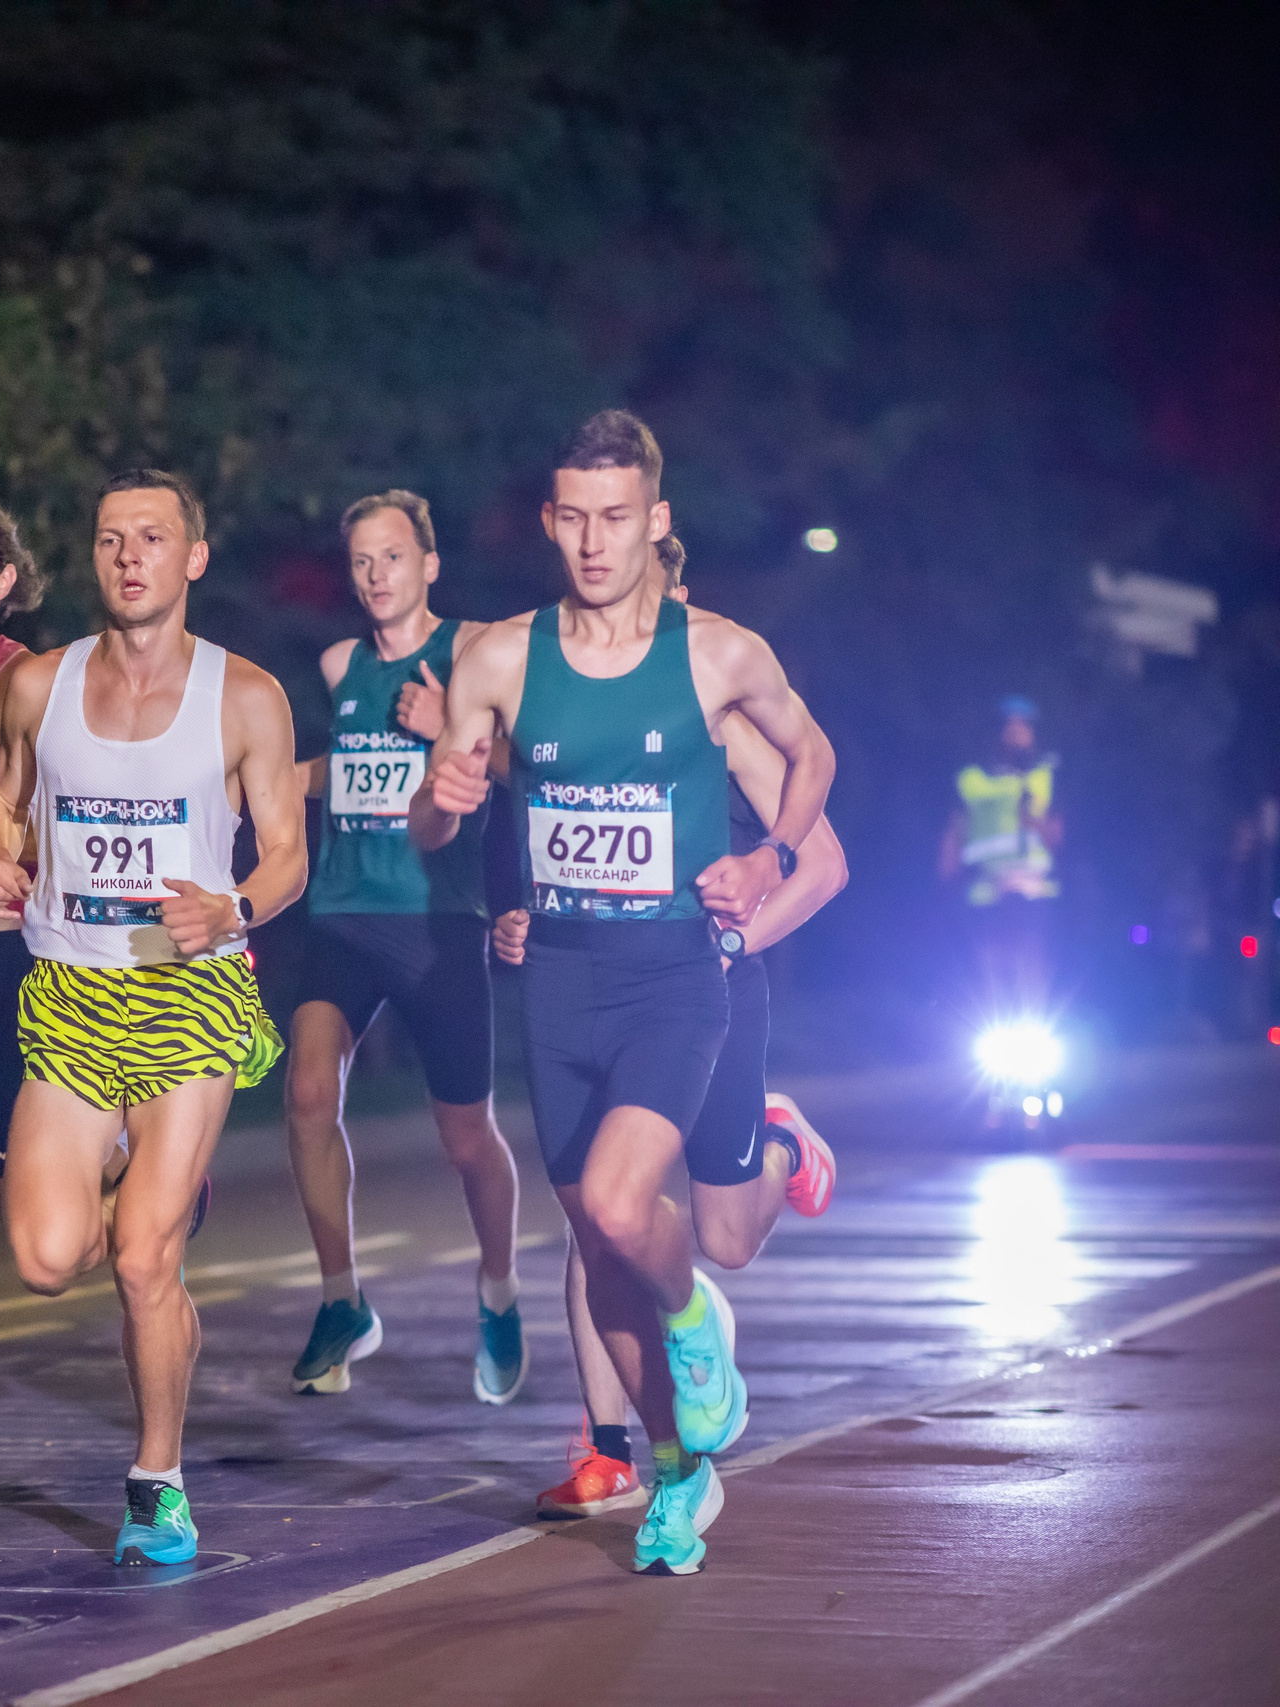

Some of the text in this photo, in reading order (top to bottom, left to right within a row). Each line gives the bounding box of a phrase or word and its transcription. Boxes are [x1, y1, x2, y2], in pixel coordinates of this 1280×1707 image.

[344, 763, 410, 793] 7397
[85, 835, 154, 875] 991
[547, 823, 652, 865] 6270
[91, 877, 153, 890] НИКОЛАЙ
[559, 867, 639, 883] АЛЕКСАНДР
